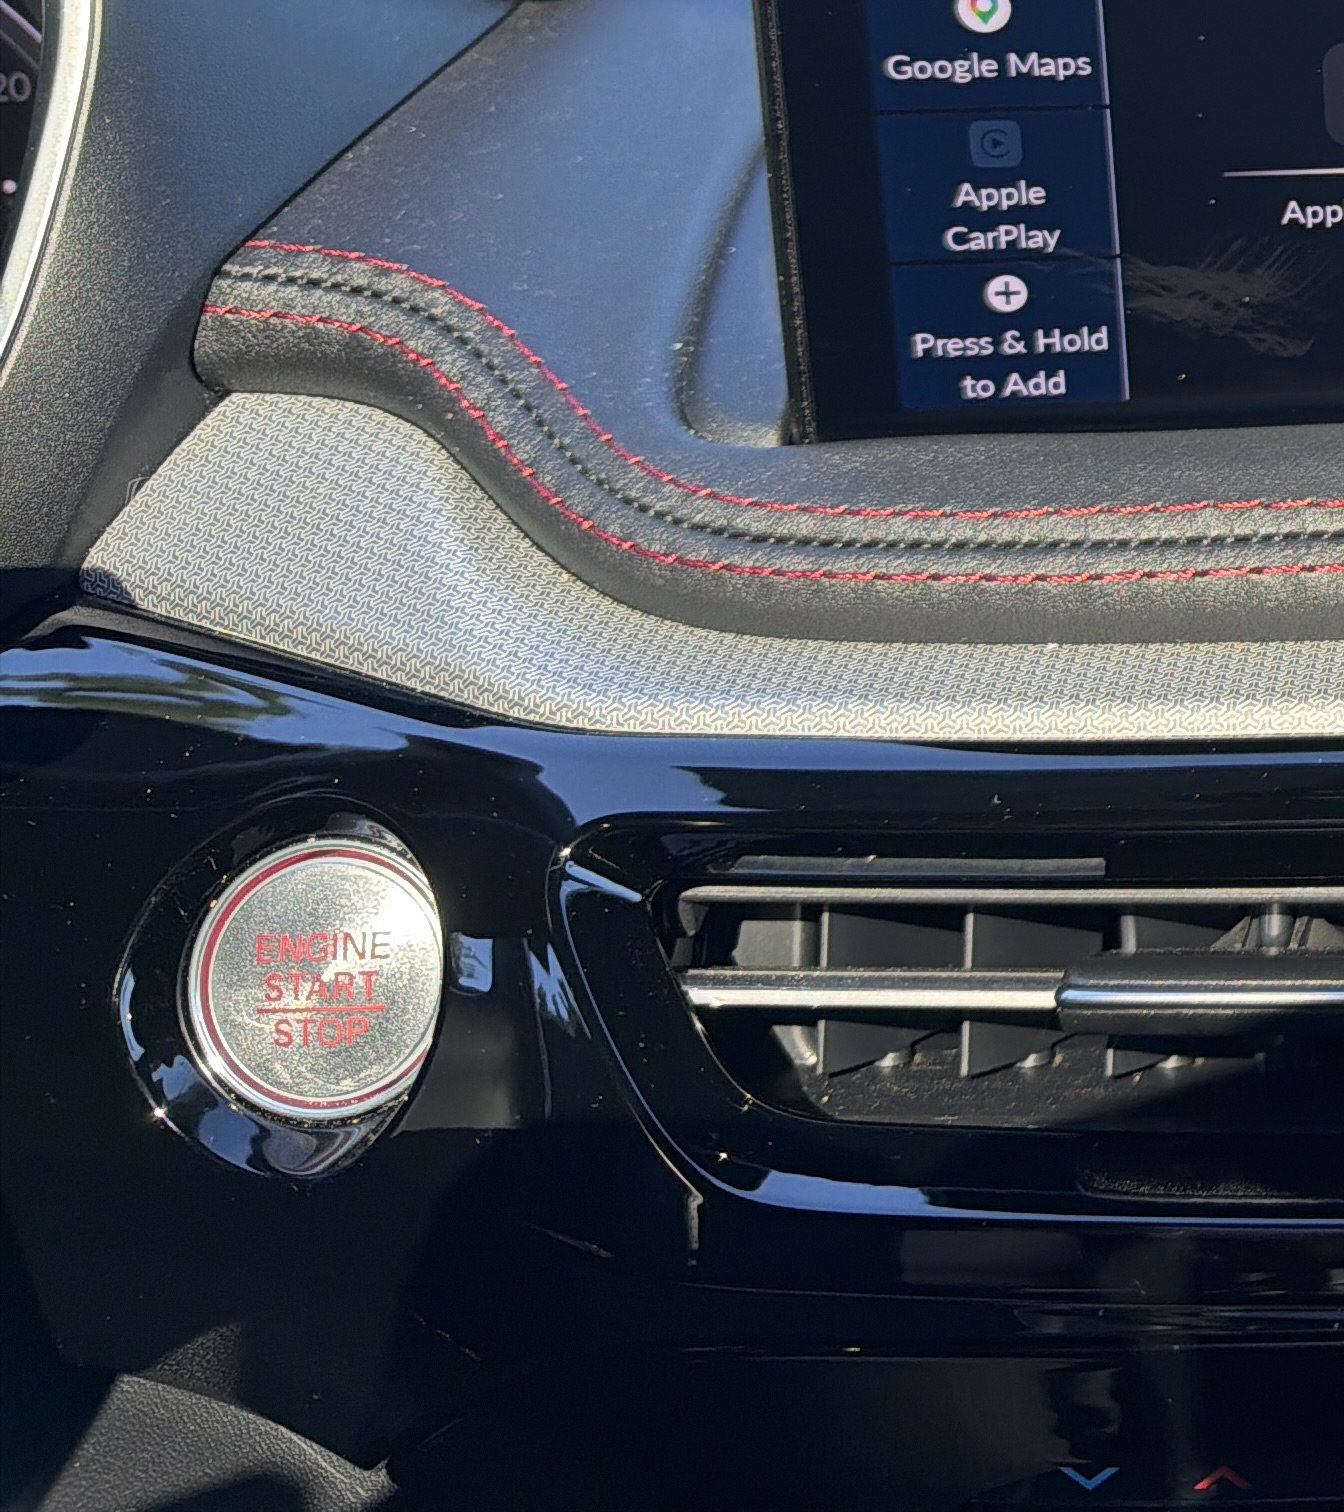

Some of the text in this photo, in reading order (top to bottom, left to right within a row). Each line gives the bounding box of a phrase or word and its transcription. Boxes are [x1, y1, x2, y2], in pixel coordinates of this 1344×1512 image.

[885, 52, 1091, 83] Google Maps
[955, 180, 1046, 211] Apple
[945, 224, 1060, 252] CarPlay
[912, 326, 1108, 357] Press & Hold
[961, 370, 1066, 398] to Add
[256, 931, 391, 964] ENGINE
[265, 971, 376, 1001] START
[274, 1016, 369, 1048] STOP
